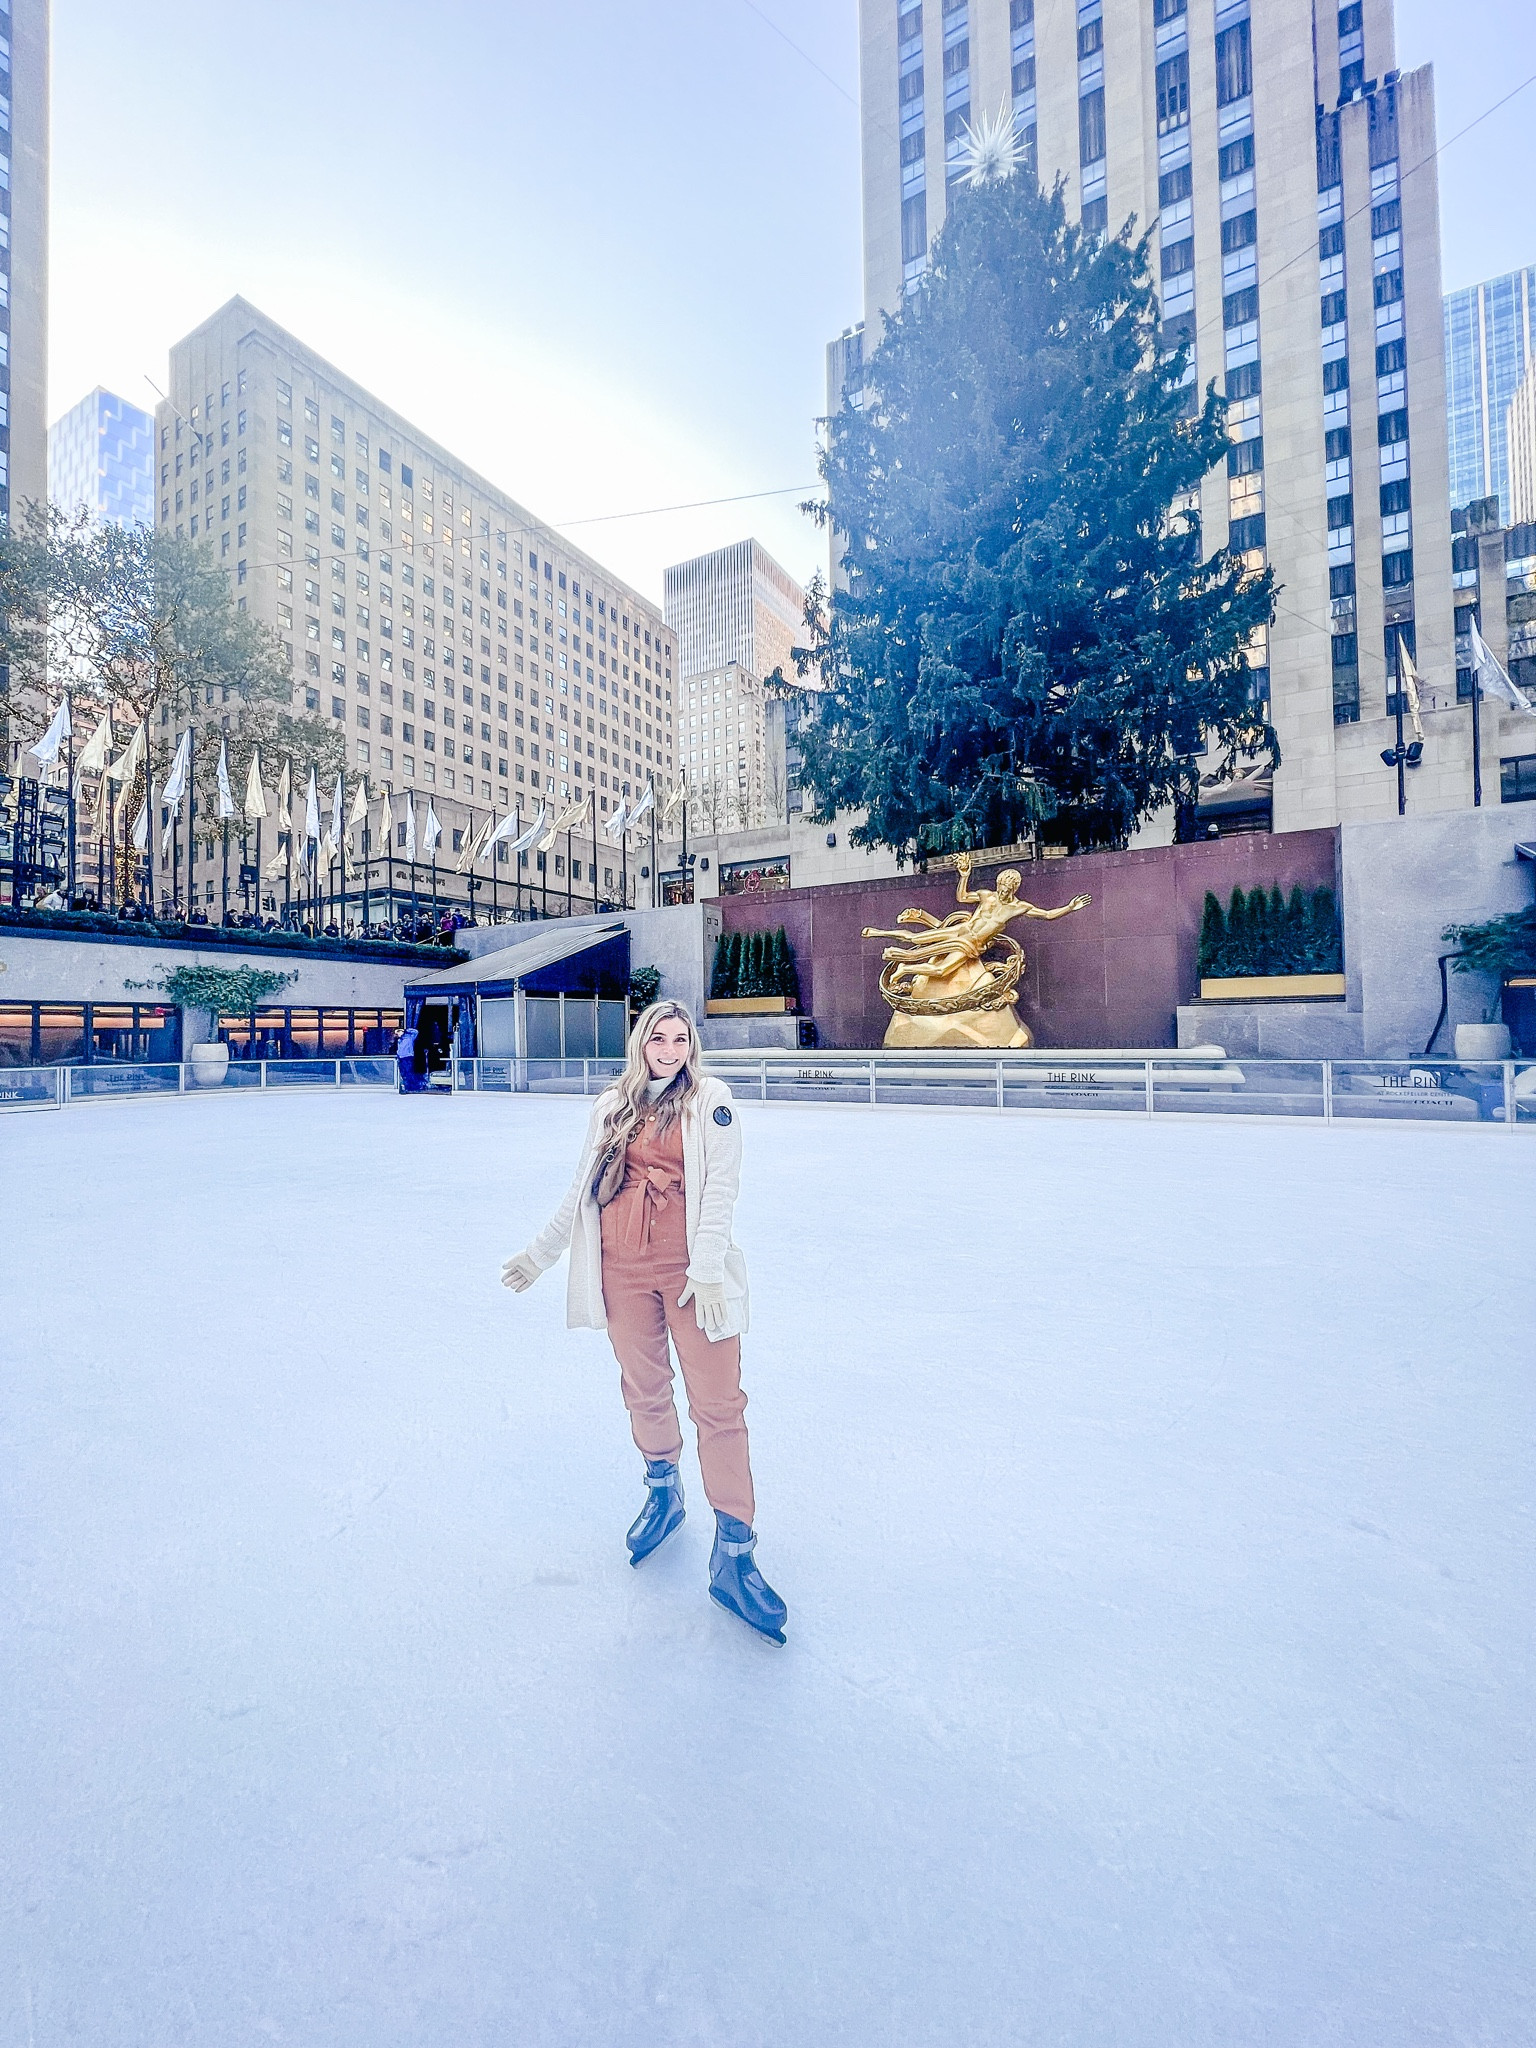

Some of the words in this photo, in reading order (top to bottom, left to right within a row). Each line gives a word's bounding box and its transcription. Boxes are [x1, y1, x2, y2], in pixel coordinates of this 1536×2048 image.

[798, 1070, 812, 1078] THE
[814, 1070, 835, 1079] RINK
[1047, 1072, 1067, 1082] THE
[1070, 1072, 1097, 1083] RINK
[1380, 1075, 1408, 1088] THE
[1414, 1076, 1449, 1088] RINK
[0, 1091, 18, 1099] INK
